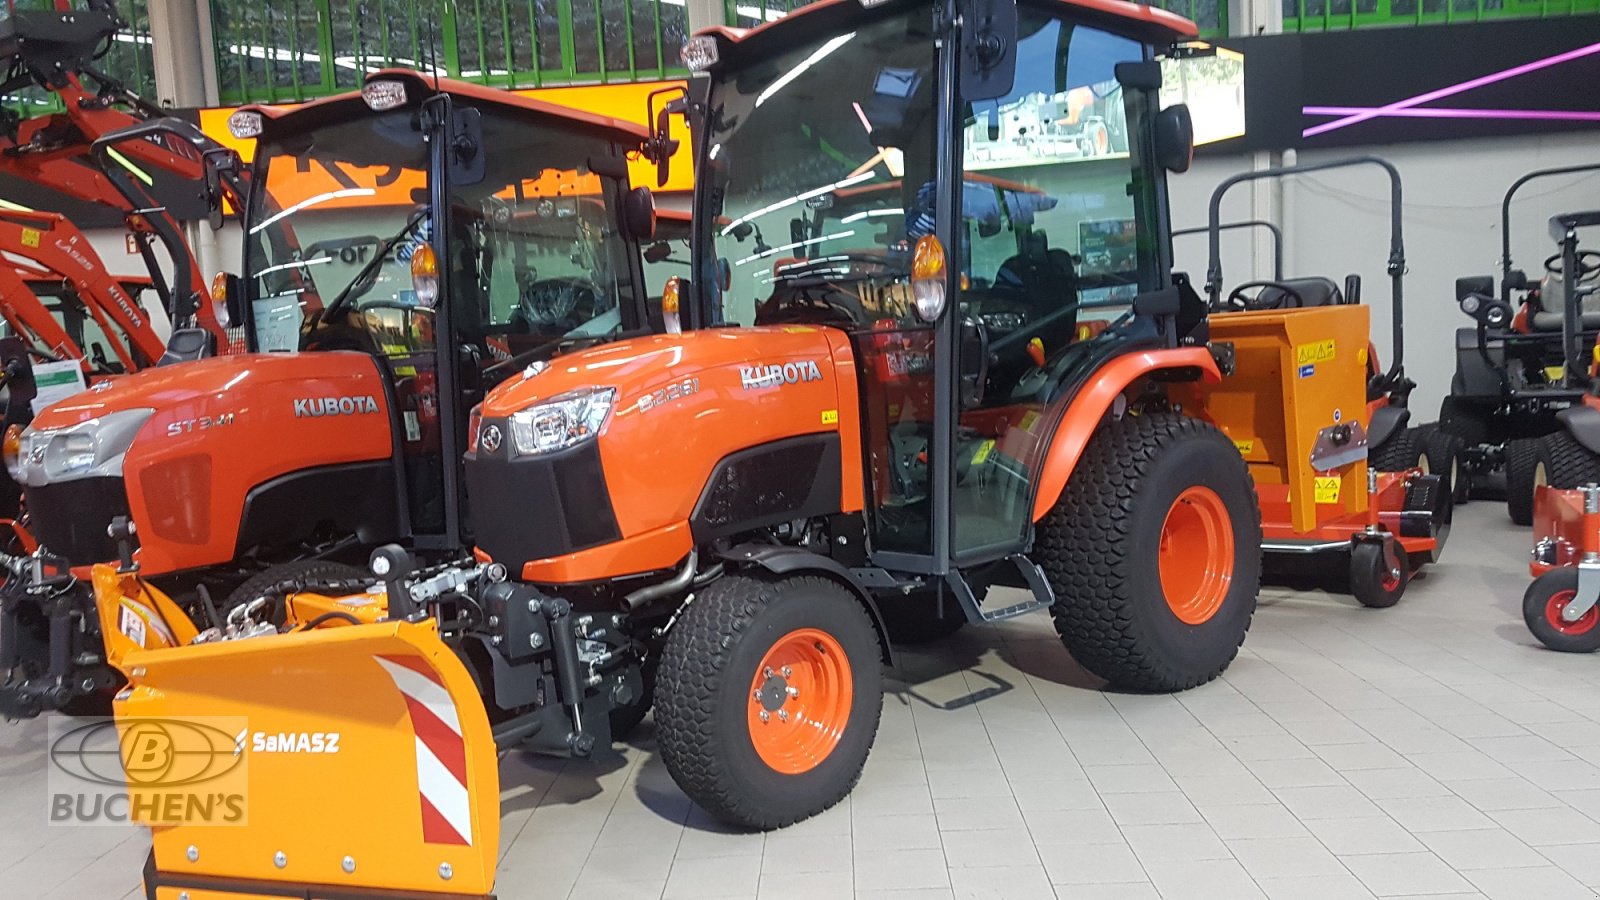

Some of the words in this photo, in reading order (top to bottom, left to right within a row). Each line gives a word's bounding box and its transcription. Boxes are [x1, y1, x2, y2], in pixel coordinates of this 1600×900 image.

[107, 284, 142, 328] KUBOTA
[739, 360, 823, 390] KUBOTA
[293, 396, 380, 417] KUBOTA
[252, 731, 340, 753] SaMASZ
